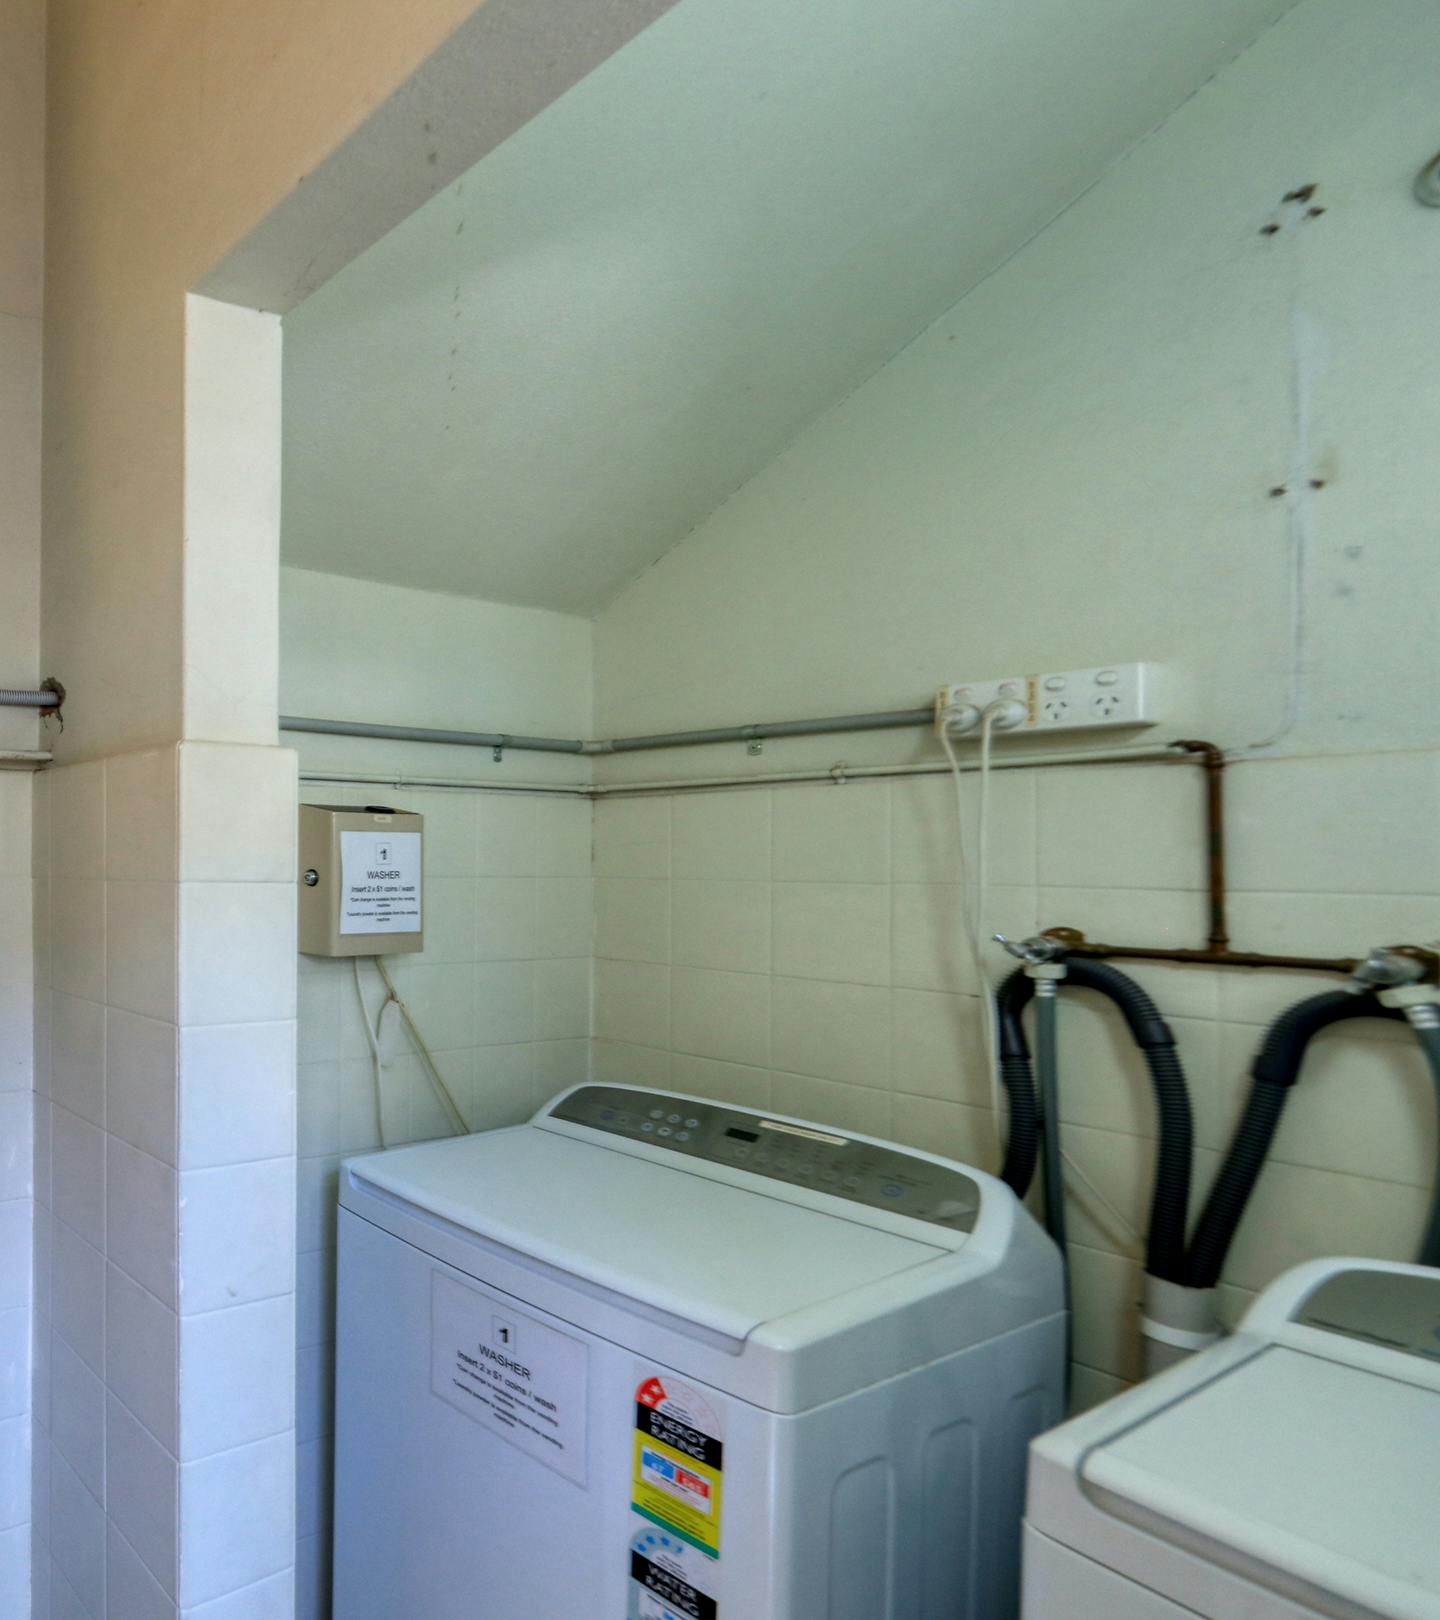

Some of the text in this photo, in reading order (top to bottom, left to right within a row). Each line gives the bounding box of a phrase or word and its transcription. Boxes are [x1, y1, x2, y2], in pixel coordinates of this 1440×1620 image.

[380, 848, 387, 860] 1
[367, 870, 401, 880] WASHER
[498, 1328, 509, 1344] 1
[478, 1343, 531, 1381] WASHER
[457, 1350, 478, 1368] Insert
[492, 1370, 502, 1382] $1
[504, 1380, 528, 1396] coins
[534, 1394, 558, 1412] wash
[650, 1411, 708, 1446] ENERGY
[650, 1424, 706, 1460] RATING
[645, 1574, 700, 1617] RATING
[648, 1563, 697, 1601] WATER
